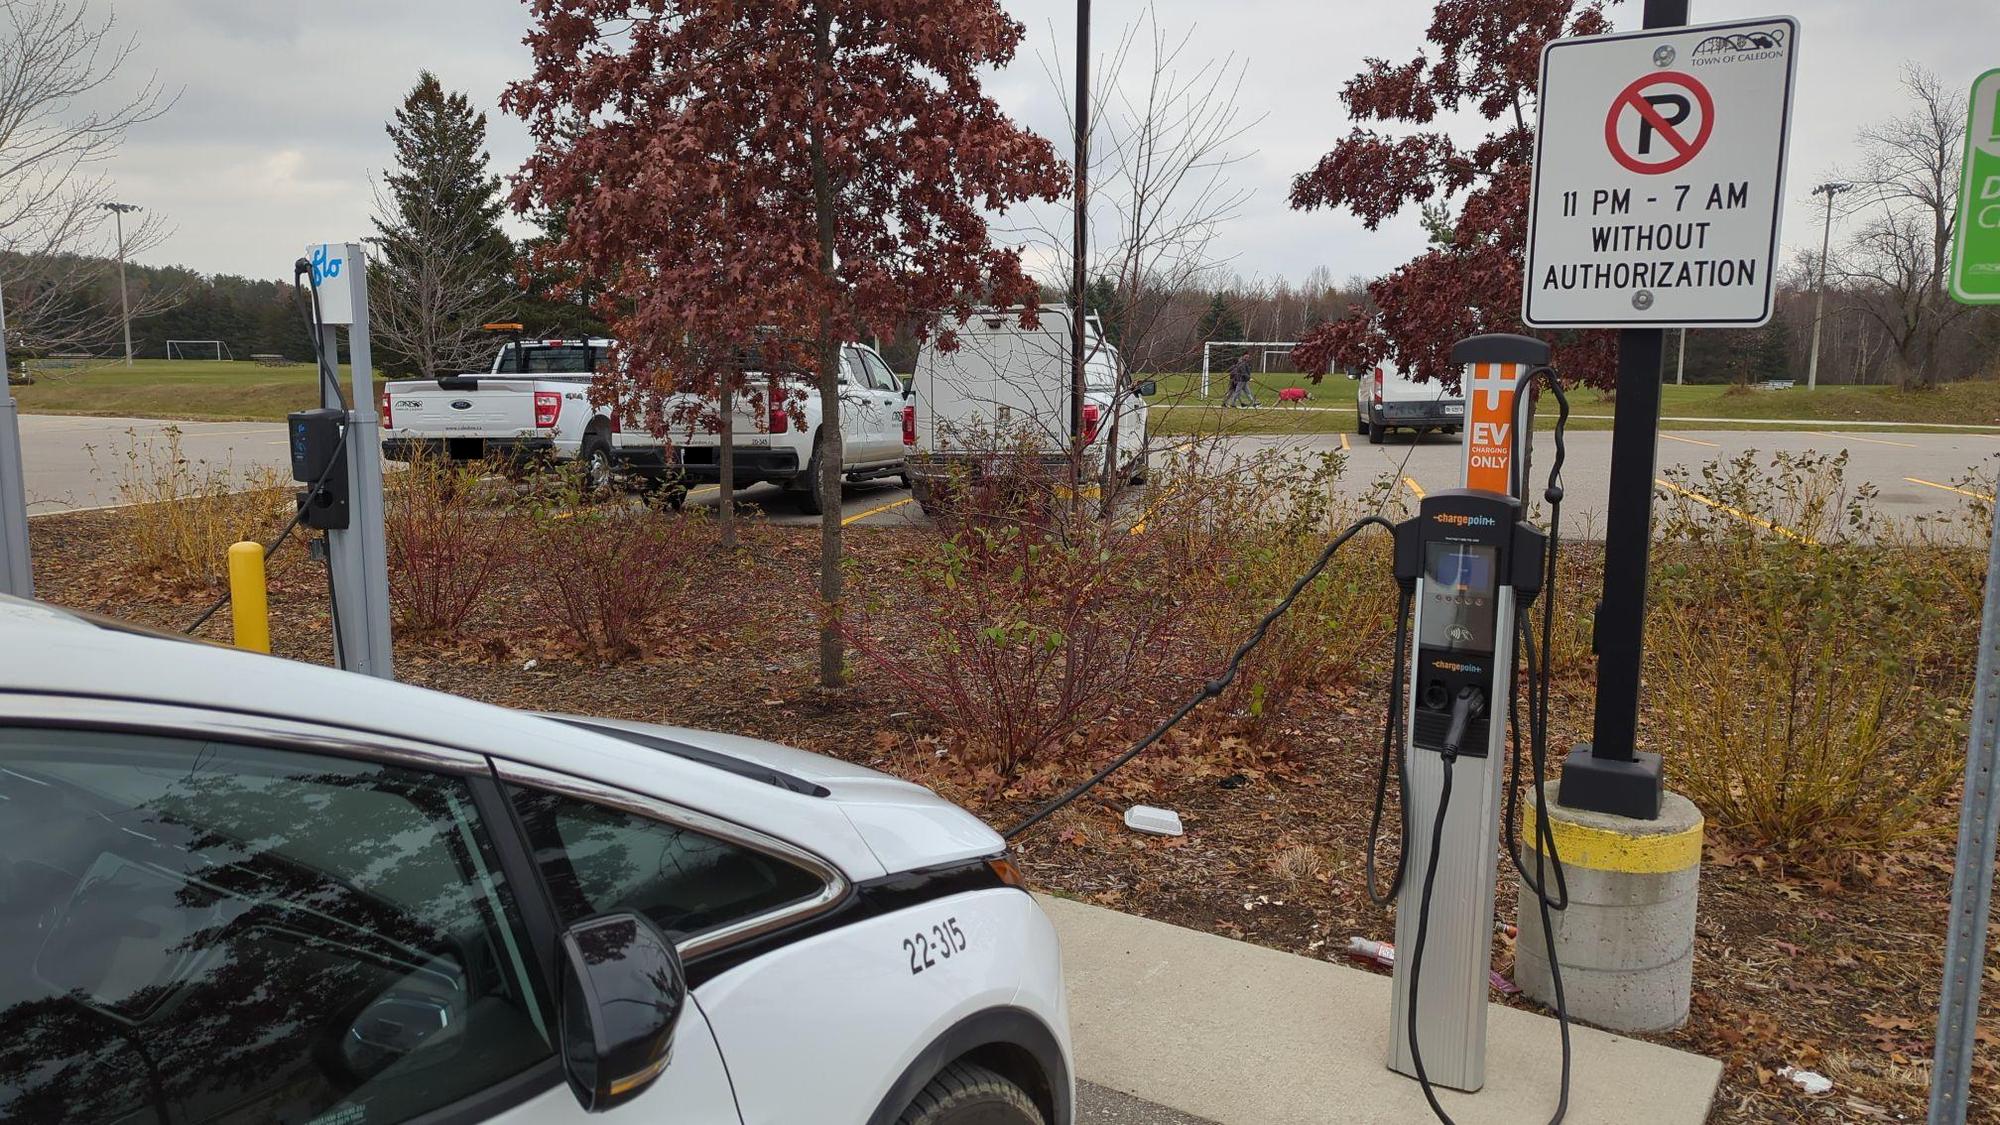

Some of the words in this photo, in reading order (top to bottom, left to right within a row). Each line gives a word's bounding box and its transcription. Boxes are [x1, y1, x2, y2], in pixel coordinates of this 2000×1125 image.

[1691, 56, 1720, 67] TOWN
[1722, 54, 1735, 64] OF
[1737, 50, 1784, 62] CALEDON
[1563, 190, 1577, 217] 11
[1592, 188, 1631, 215] PM
[1675, 185, 1690, 212] 7
[1706, 181, 1749, 210] AM
[1591, 222, 1711, 252] WITHOUT
[312, 244, 342, 287] flo
[1543, 259, 1756, 290] AUTHORIZATION
[1473, 422, 1510, 446] EV
[1471, 446, 1508, 454] CHARGING
[1471, 455, 1508, 469] ONLY
[903, 917, 966, 975] 22-315
